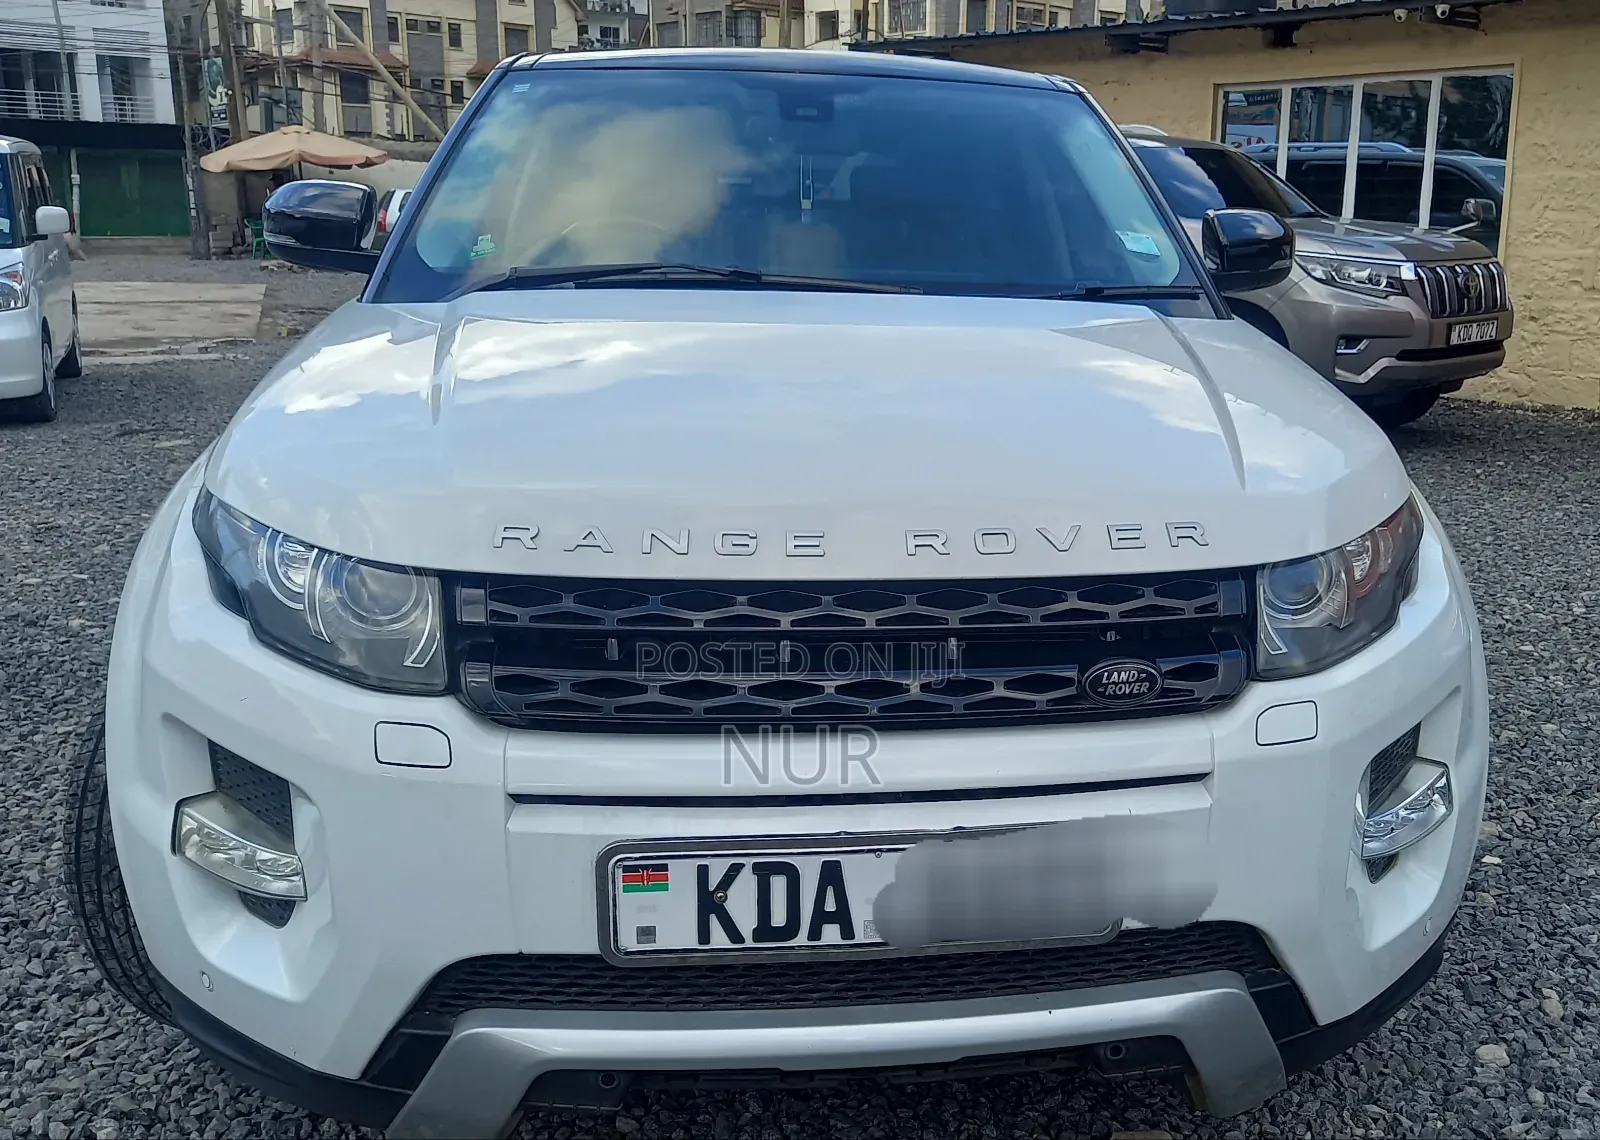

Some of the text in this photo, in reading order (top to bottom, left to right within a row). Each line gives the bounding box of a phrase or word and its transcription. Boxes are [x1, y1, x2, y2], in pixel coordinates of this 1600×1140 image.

[493, 521, 1209, 557] RANGE ROVER
[1101, 670, 1139, 684] LAND
[1105, 682, 1150, 696] ROVER
[696, 859, 856, 945] KDA
